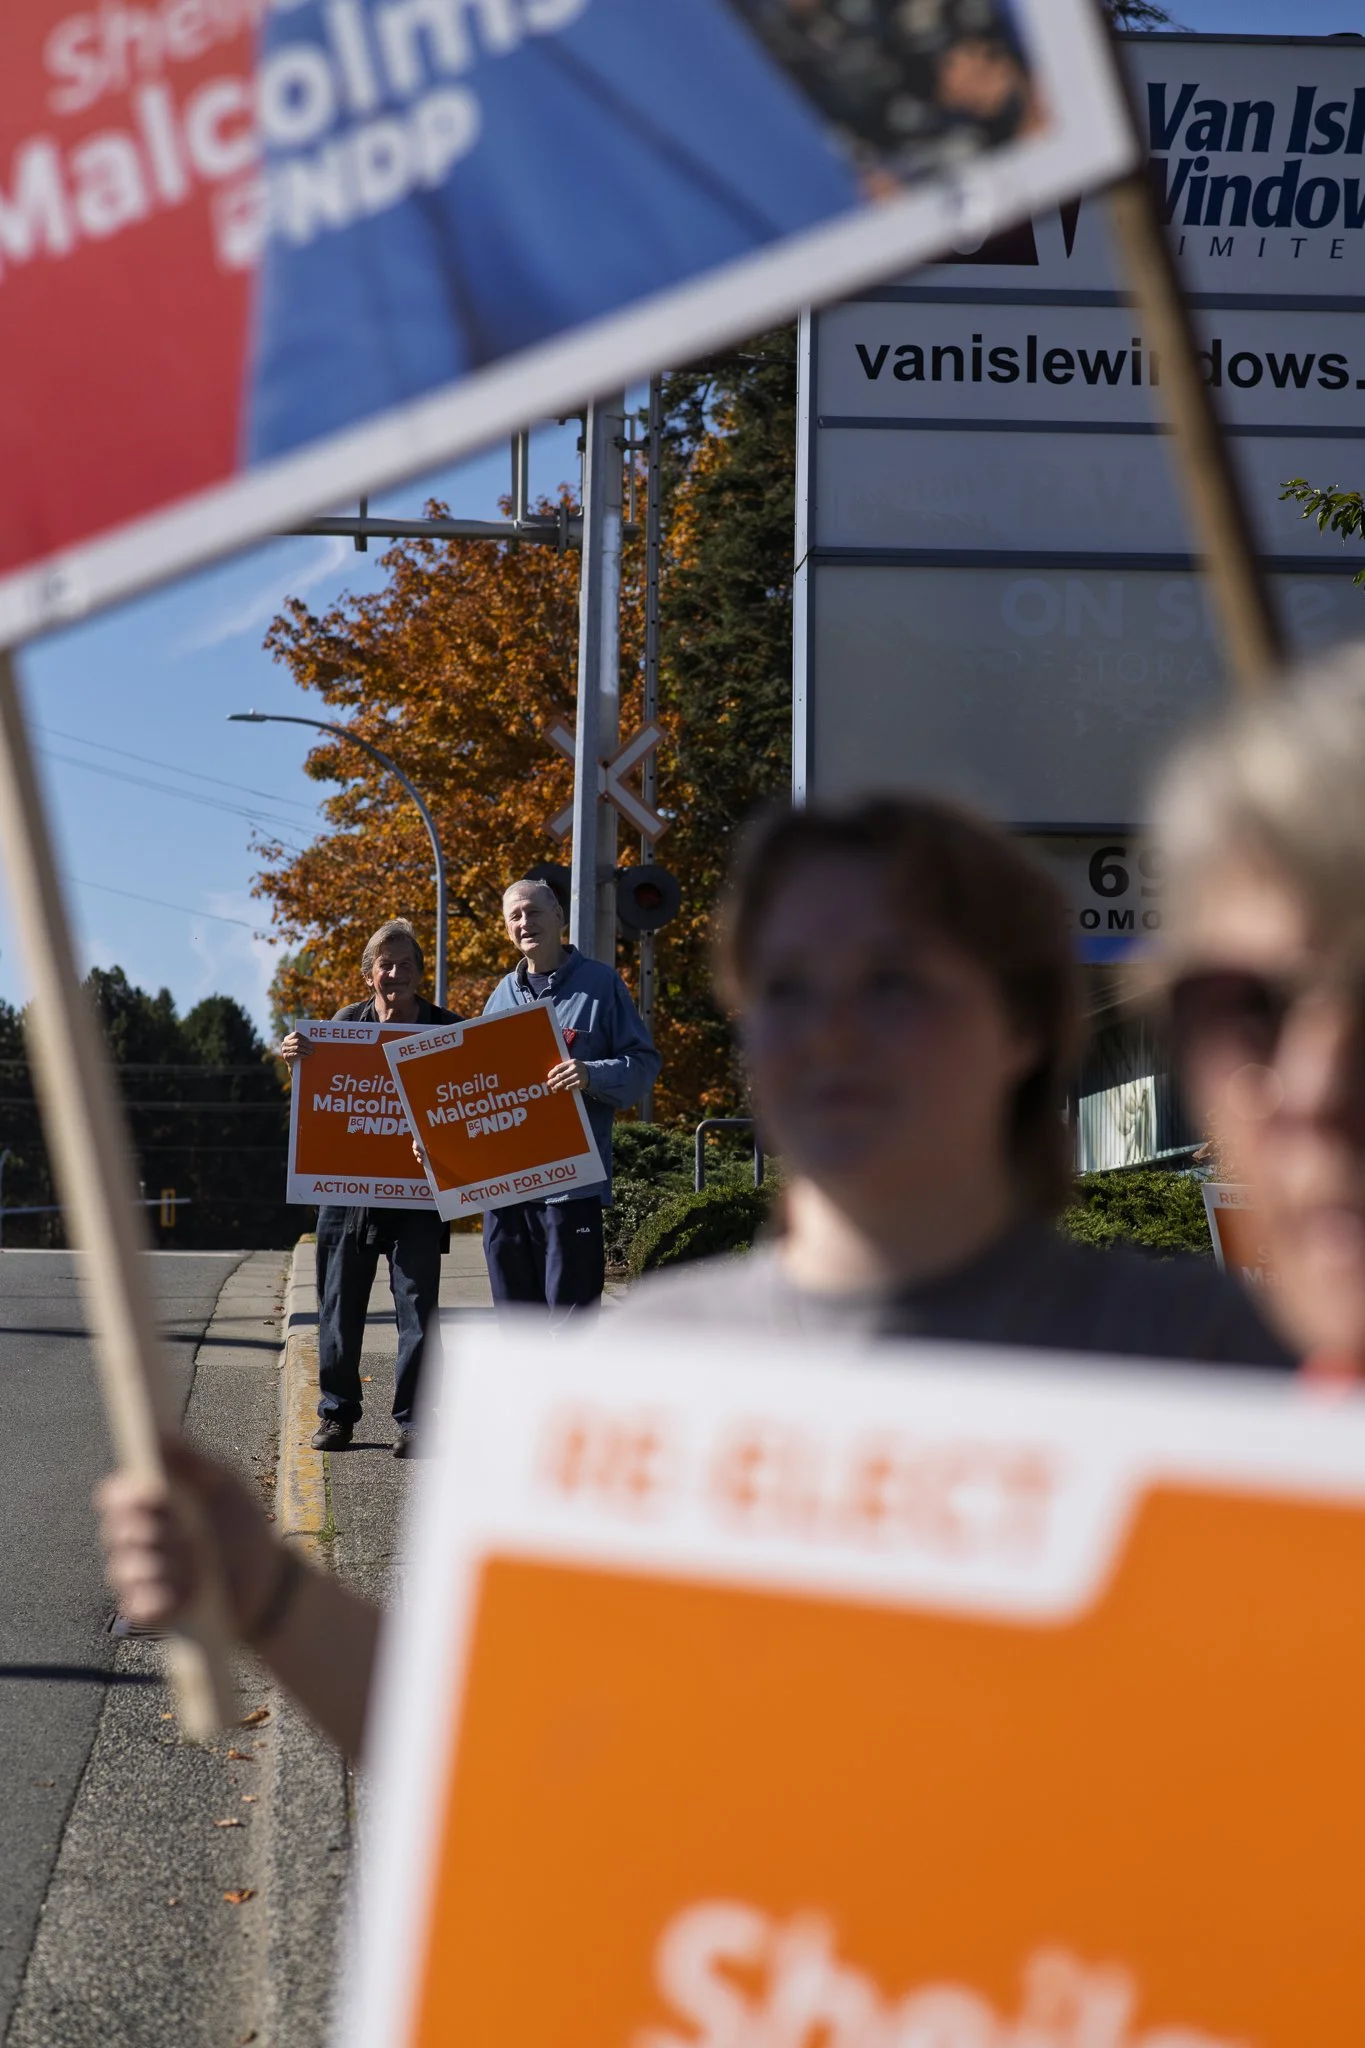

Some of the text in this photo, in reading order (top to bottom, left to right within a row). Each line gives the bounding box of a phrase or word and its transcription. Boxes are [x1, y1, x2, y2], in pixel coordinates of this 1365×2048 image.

[1147, 82, 1275, 153] Van
[1177, 235, 1346, 260] IMITE
[855, 333, 1365, 390] vanislewidows.
[1066, 907, 1162, 931] OMO
[309, 1027, 373, 1040] RE-ELECT
[398, 1032, 457, 1057] RE-ELECT
[436, 1073, 499, 1103] Sheila
[481, 1107, 528, 1135] NDP
[312, 1181, 369, 1195] ACTION
[374, 1183, 405, 1197] FOR
[459, 1163, 577, 1205] ACTION FOR YOU
